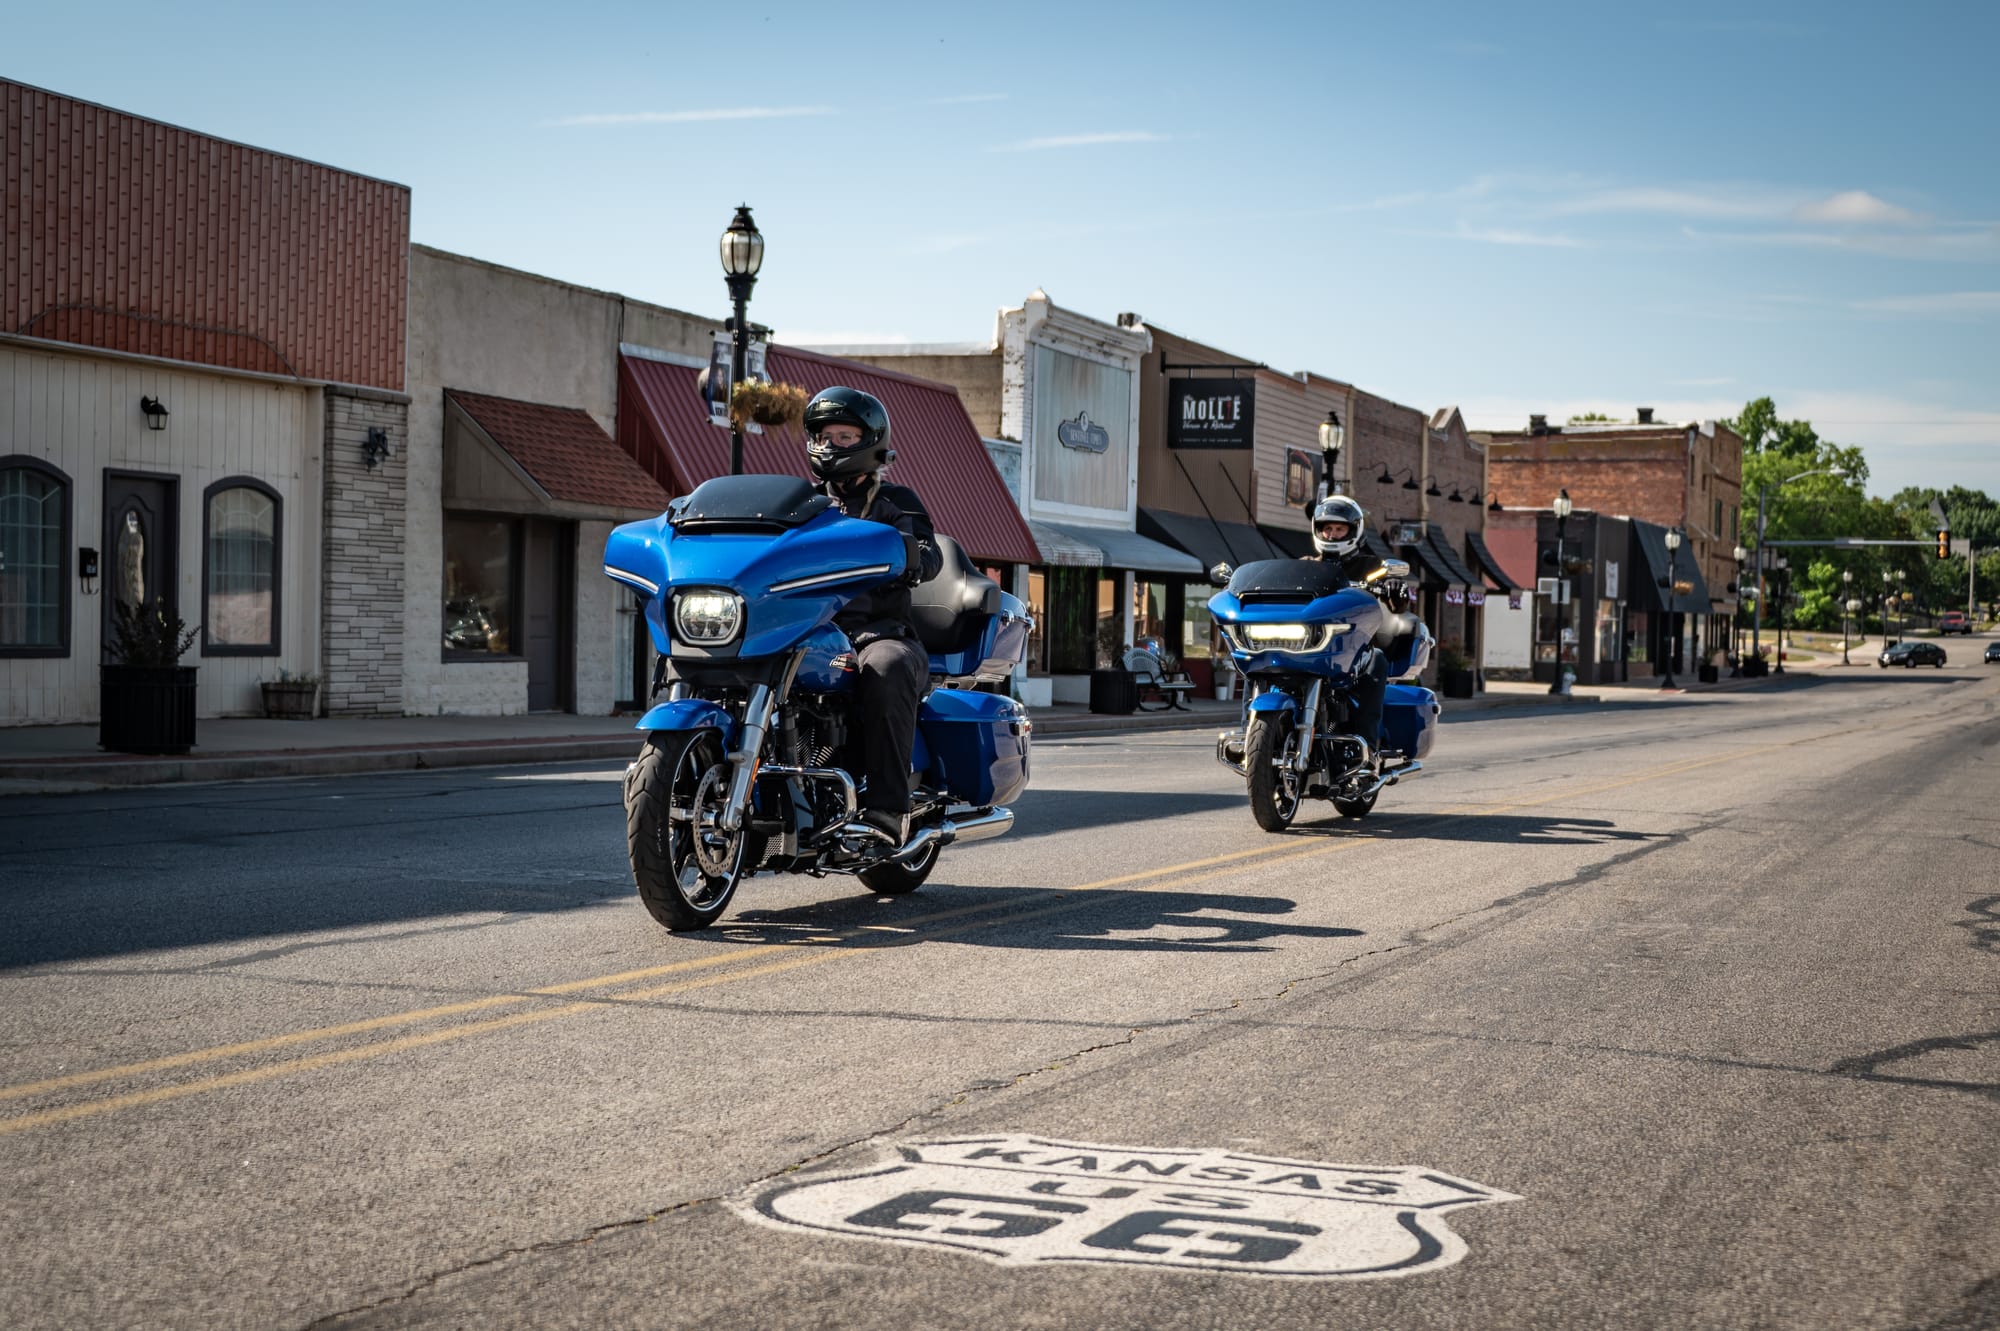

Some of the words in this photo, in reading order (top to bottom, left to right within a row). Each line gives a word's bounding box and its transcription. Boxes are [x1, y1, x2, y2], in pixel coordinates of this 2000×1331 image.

[963, 1148, 1400, 1195] KANSAS
[1027, 1181, 1253, 1209] US
[844, 1190, 1322, 1262] 66
